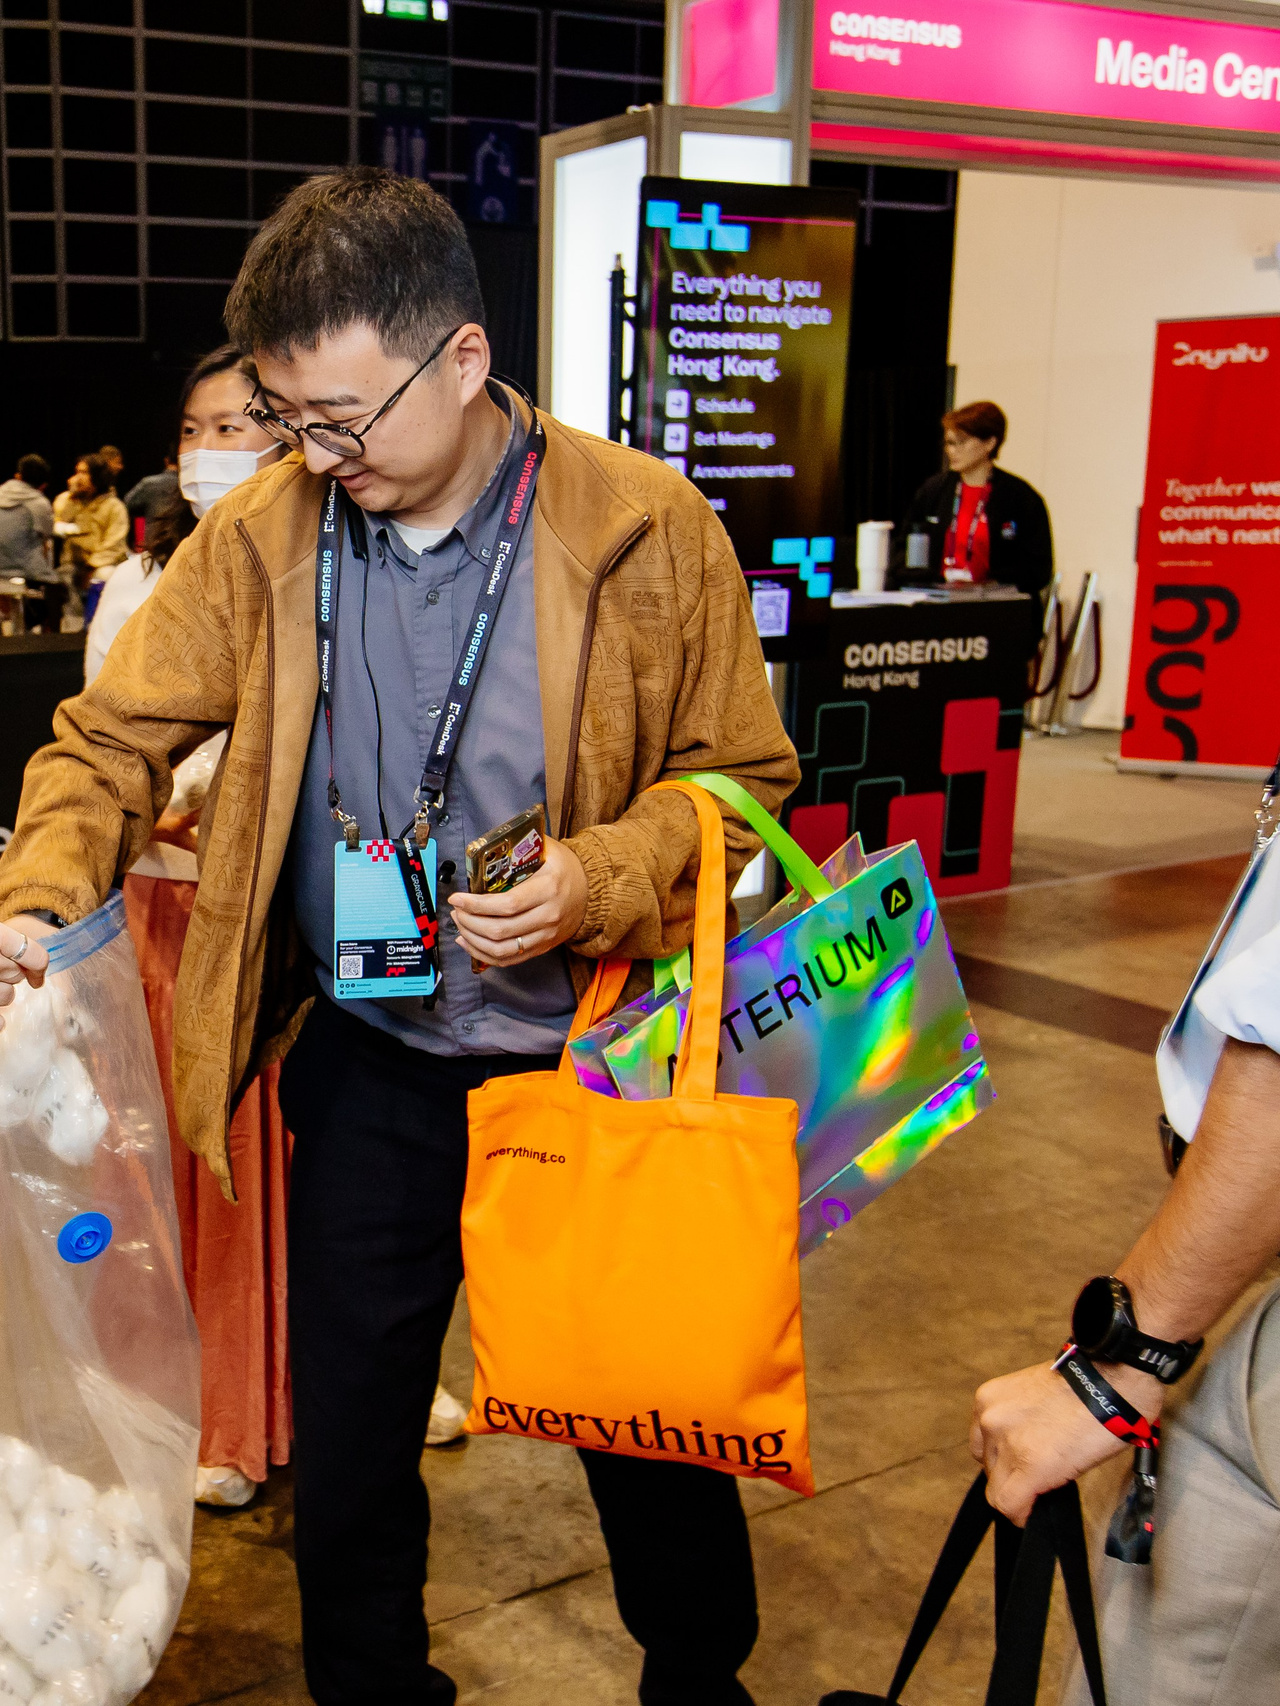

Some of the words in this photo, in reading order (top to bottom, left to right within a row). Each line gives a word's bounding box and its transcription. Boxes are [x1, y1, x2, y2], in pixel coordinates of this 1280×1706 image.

[830, 11, 962, 48] CONSENSUS
[829, 40, 865, 62] Hong
[866, 43, 902, 66] Kong
[1095, 37, 1208, 94] Media
[672, 270, 783, 302] Everything
[784, 280, 822, 303] you
[670, 300, 723, 322] need
[724, 302, 747, 323] to
[748, 302, 832, 330] navigate
[669, 326, 782, 351] Consensus
[667, 354, 723, 382] Hong
[723, 354, 781, 382] Kong.
[695, 398, 756, 414] Schedule
[693, 431, 717, 446] Set
[717, 431, 776, 449] Meetings
[508, 451, 538, 525] CONSENSUS
[691, 464, 796, 479] Announcements
[326, 479, 337, 521] CoinDesk
[1166, 476, 1247, 504] Together
[1160, 502, 1280, 521] communic
[1158, 526, 1229, 545] what's
[321, 549, 333, 622] CONSENSUS
[486, 552, 507, 596] CoinDesk
[321, 639, 330, 681] CoinDesk
[458, 612, 488, 686] CONSENSUS
[844, 636, 989, 669] CONSENSUS
[843, 673, 881, 692] Hong
[882, 670, 919, 689] Kong
[436, 714, 456, 756] CoinDesk
[410, 873, 428, 915] GRAYSCALE
[397, 945, 424, 953] midnight
[486, 1147, 566, 1164] everything.co
[1067, 1360, 1120, 1416] GRAYSCALE
[483, 1396, 792, 1474] everything
